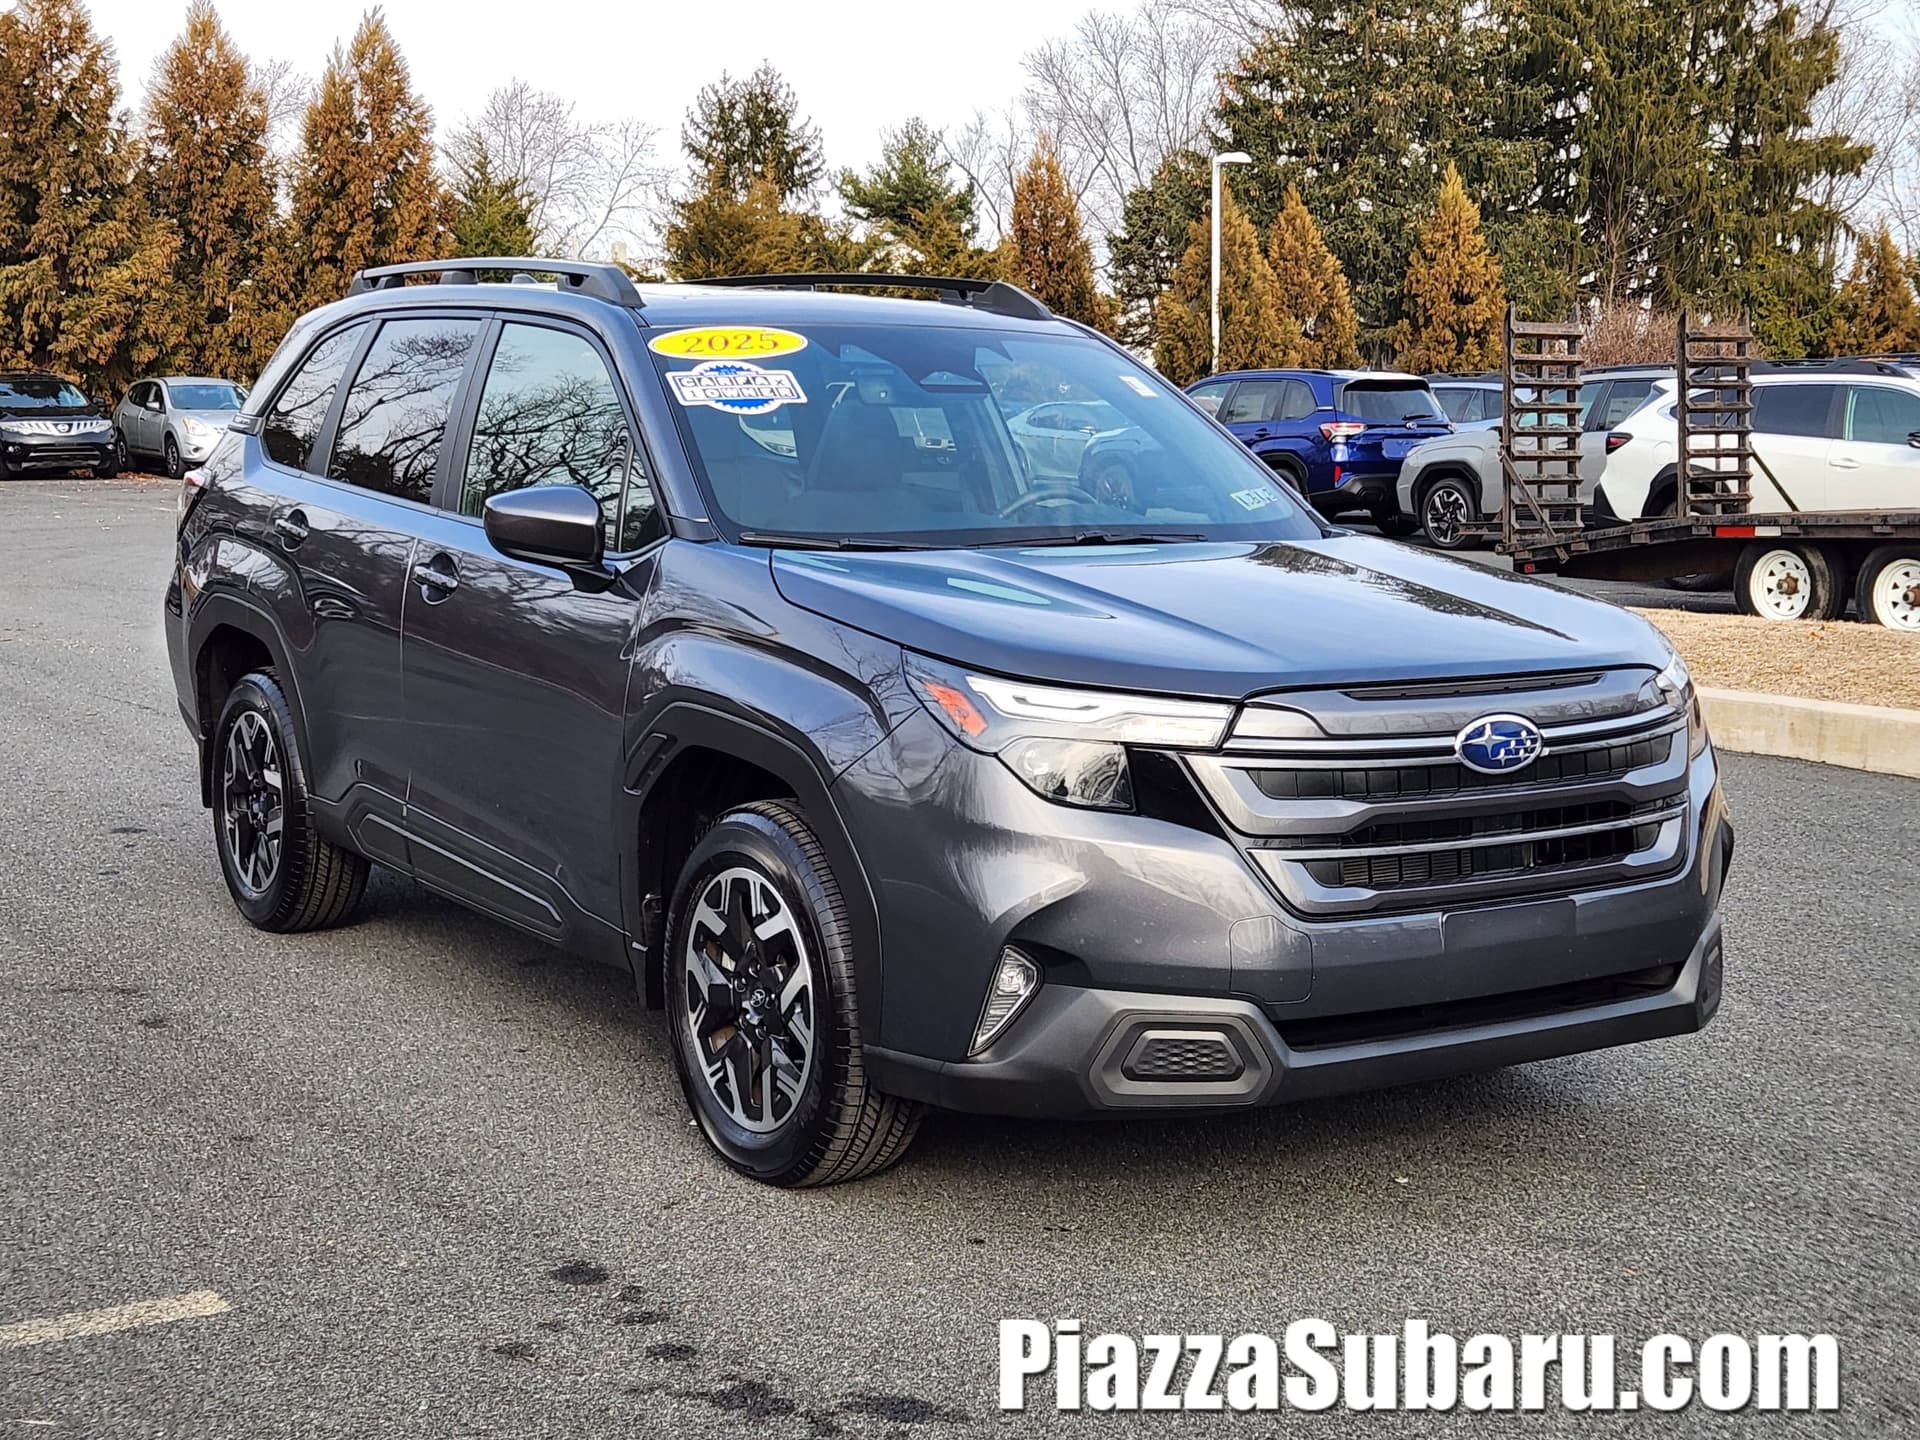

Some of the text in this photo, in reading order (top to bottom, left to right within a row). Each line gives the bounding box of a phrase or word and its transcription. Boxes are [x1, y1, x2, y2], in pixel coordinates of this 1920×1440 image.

[683, 332, 779, 353] 2025
[679, 376, 784, 388] CARFAX
[704, 387, 795, 399] OWNER
